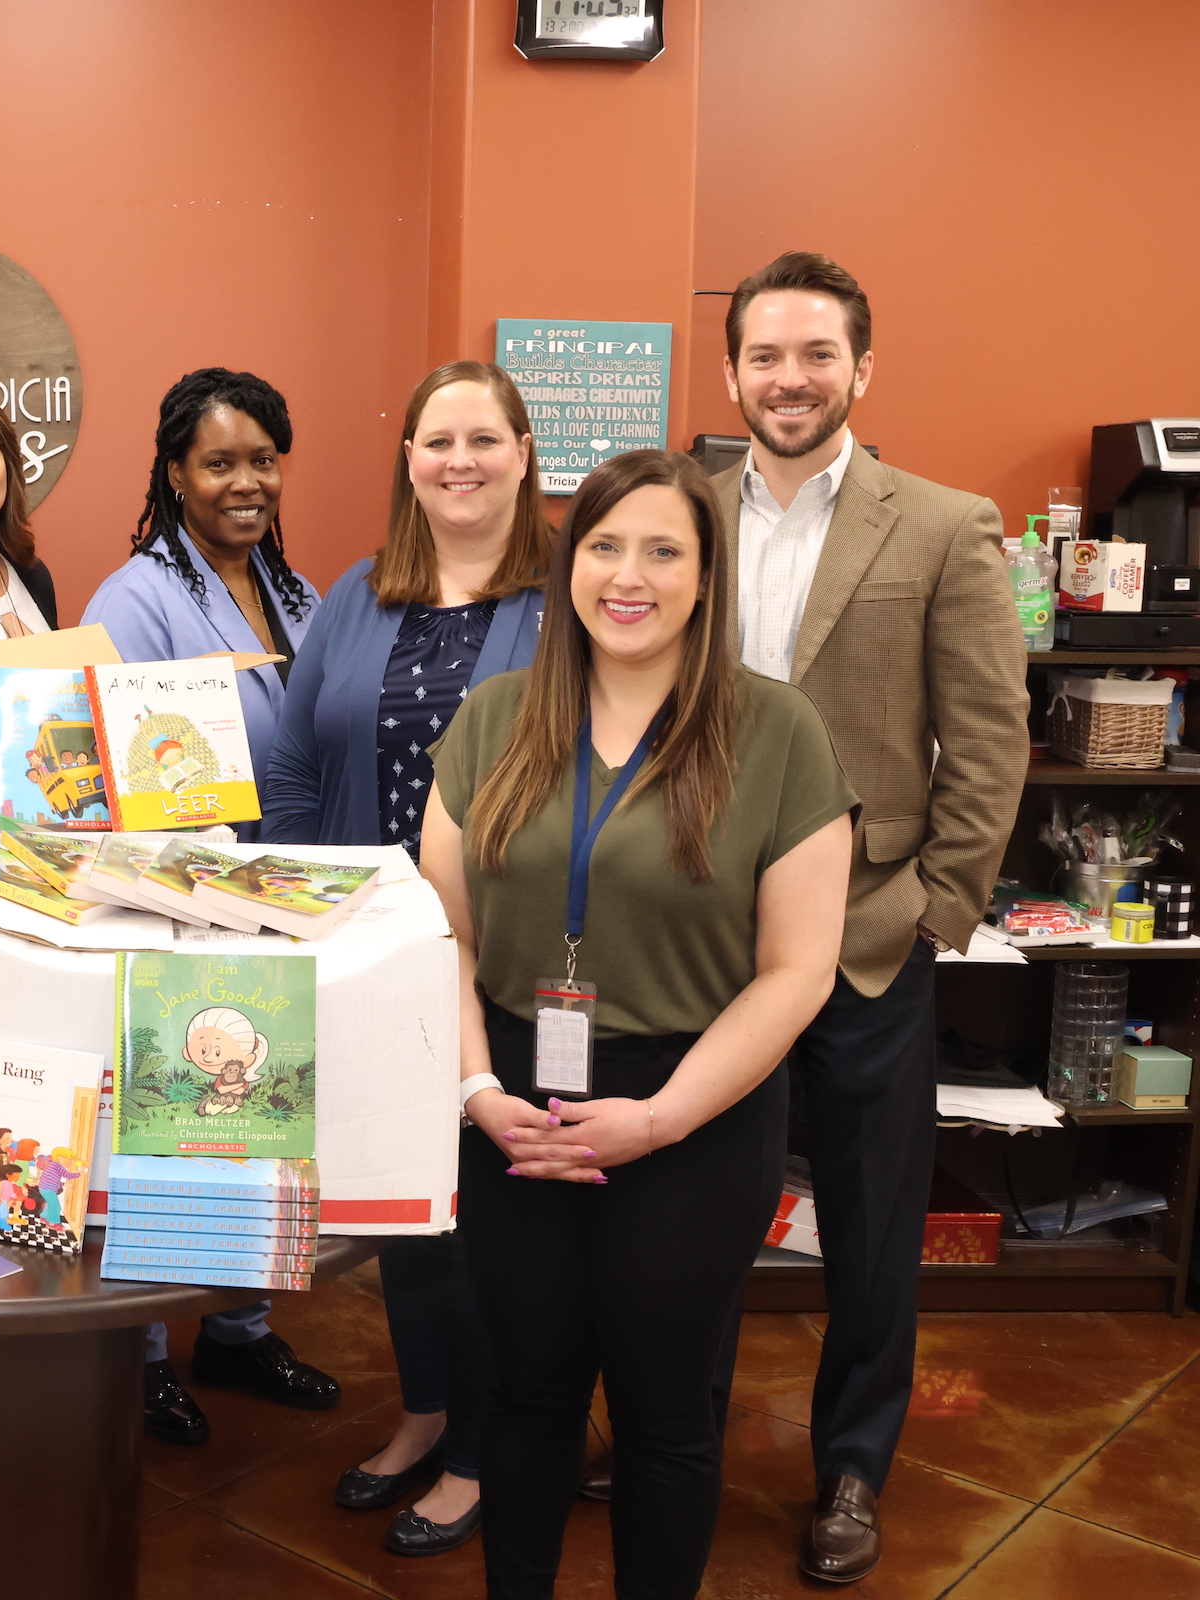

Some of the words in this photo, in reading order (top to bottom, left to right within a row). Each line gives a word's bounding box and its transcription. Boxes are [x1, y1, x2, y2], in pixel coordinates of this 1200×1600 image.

[560, 20, 567, 33] 2
[533, 329, 542, 337] a
[546, 328, 586, 340] great
[506, 339, 663, 355] PRINCIPAL
[505, 352, 565, 370] Builds
[569, 354, 663, 372] Character
[588, 372, 662, 387] DREAMS
[588, 387, 663, 404] CREATIVITY
[565, 406, 661, 421] CONFIDENCE
[552, 422, 561, 436] A
[563, 422, 590, 437] LOVE
[591, 423, 606, 437] OF
[608, 423, 660, 438] LEARNING
[562, 440, 587, 449] Our
[615, 441, 660, 450] Hearts
[569, 452, 589, 468] Our
[547, 476, 577, 486] Tricia
[1122, 562, 1130, 595] COFFEE
[1128, 557, 1136, 599] CREAMER
[108, 678, 120, 693] A
[126, 676, 145, 690] MÍ
[155, 680, 176, 693] ME
[186, 679, 229, 691] GUSTA
[161, 793, 226, 816] LEER
[181, 813, 217, 821] SCHOLASTIC
[10, 891, 35, 906] León
[206, 962, 213, 975] I
[216, 964, 239, 975] am
[155, 988, 199, 1018] Jane
[206, 977, 291, 1017] Goodall
[2, 1061, 45, 1086] Rang
[175, 1117, 201, 1127] BRAD
[205, 1118, 251, 1128] MELTZER
[138, 1129, 169, 1138] illustrated
[170, 1130, 179, 1140] by
[179, 1129, 234, 1140] Christopher
[238, 1131, 287, 1141] Eliopoulos
[187, 1143, 245, 1151] SCHOLASTIC
[127, 1180, 203, 1196] Esperanza
[213, 1187, 258, 1196] renace
[127, 1198, 203, 1213] Esperanza
[213, 1205, 258, 1213] renace
[127, 1216, 203, 1231] Esperanza
[213, 1223, 258, 1232] renace
[126, 1233, 202, 1248] Esperanza
[212, 1240, 256, 1249] renace
[124, 1251, 199, 1266] Esperanza
[209, 1258, 253, 1267] renace
[121, 1267, 195, 1283] Esperanza
[205, 1275, 250, 1284] renace
